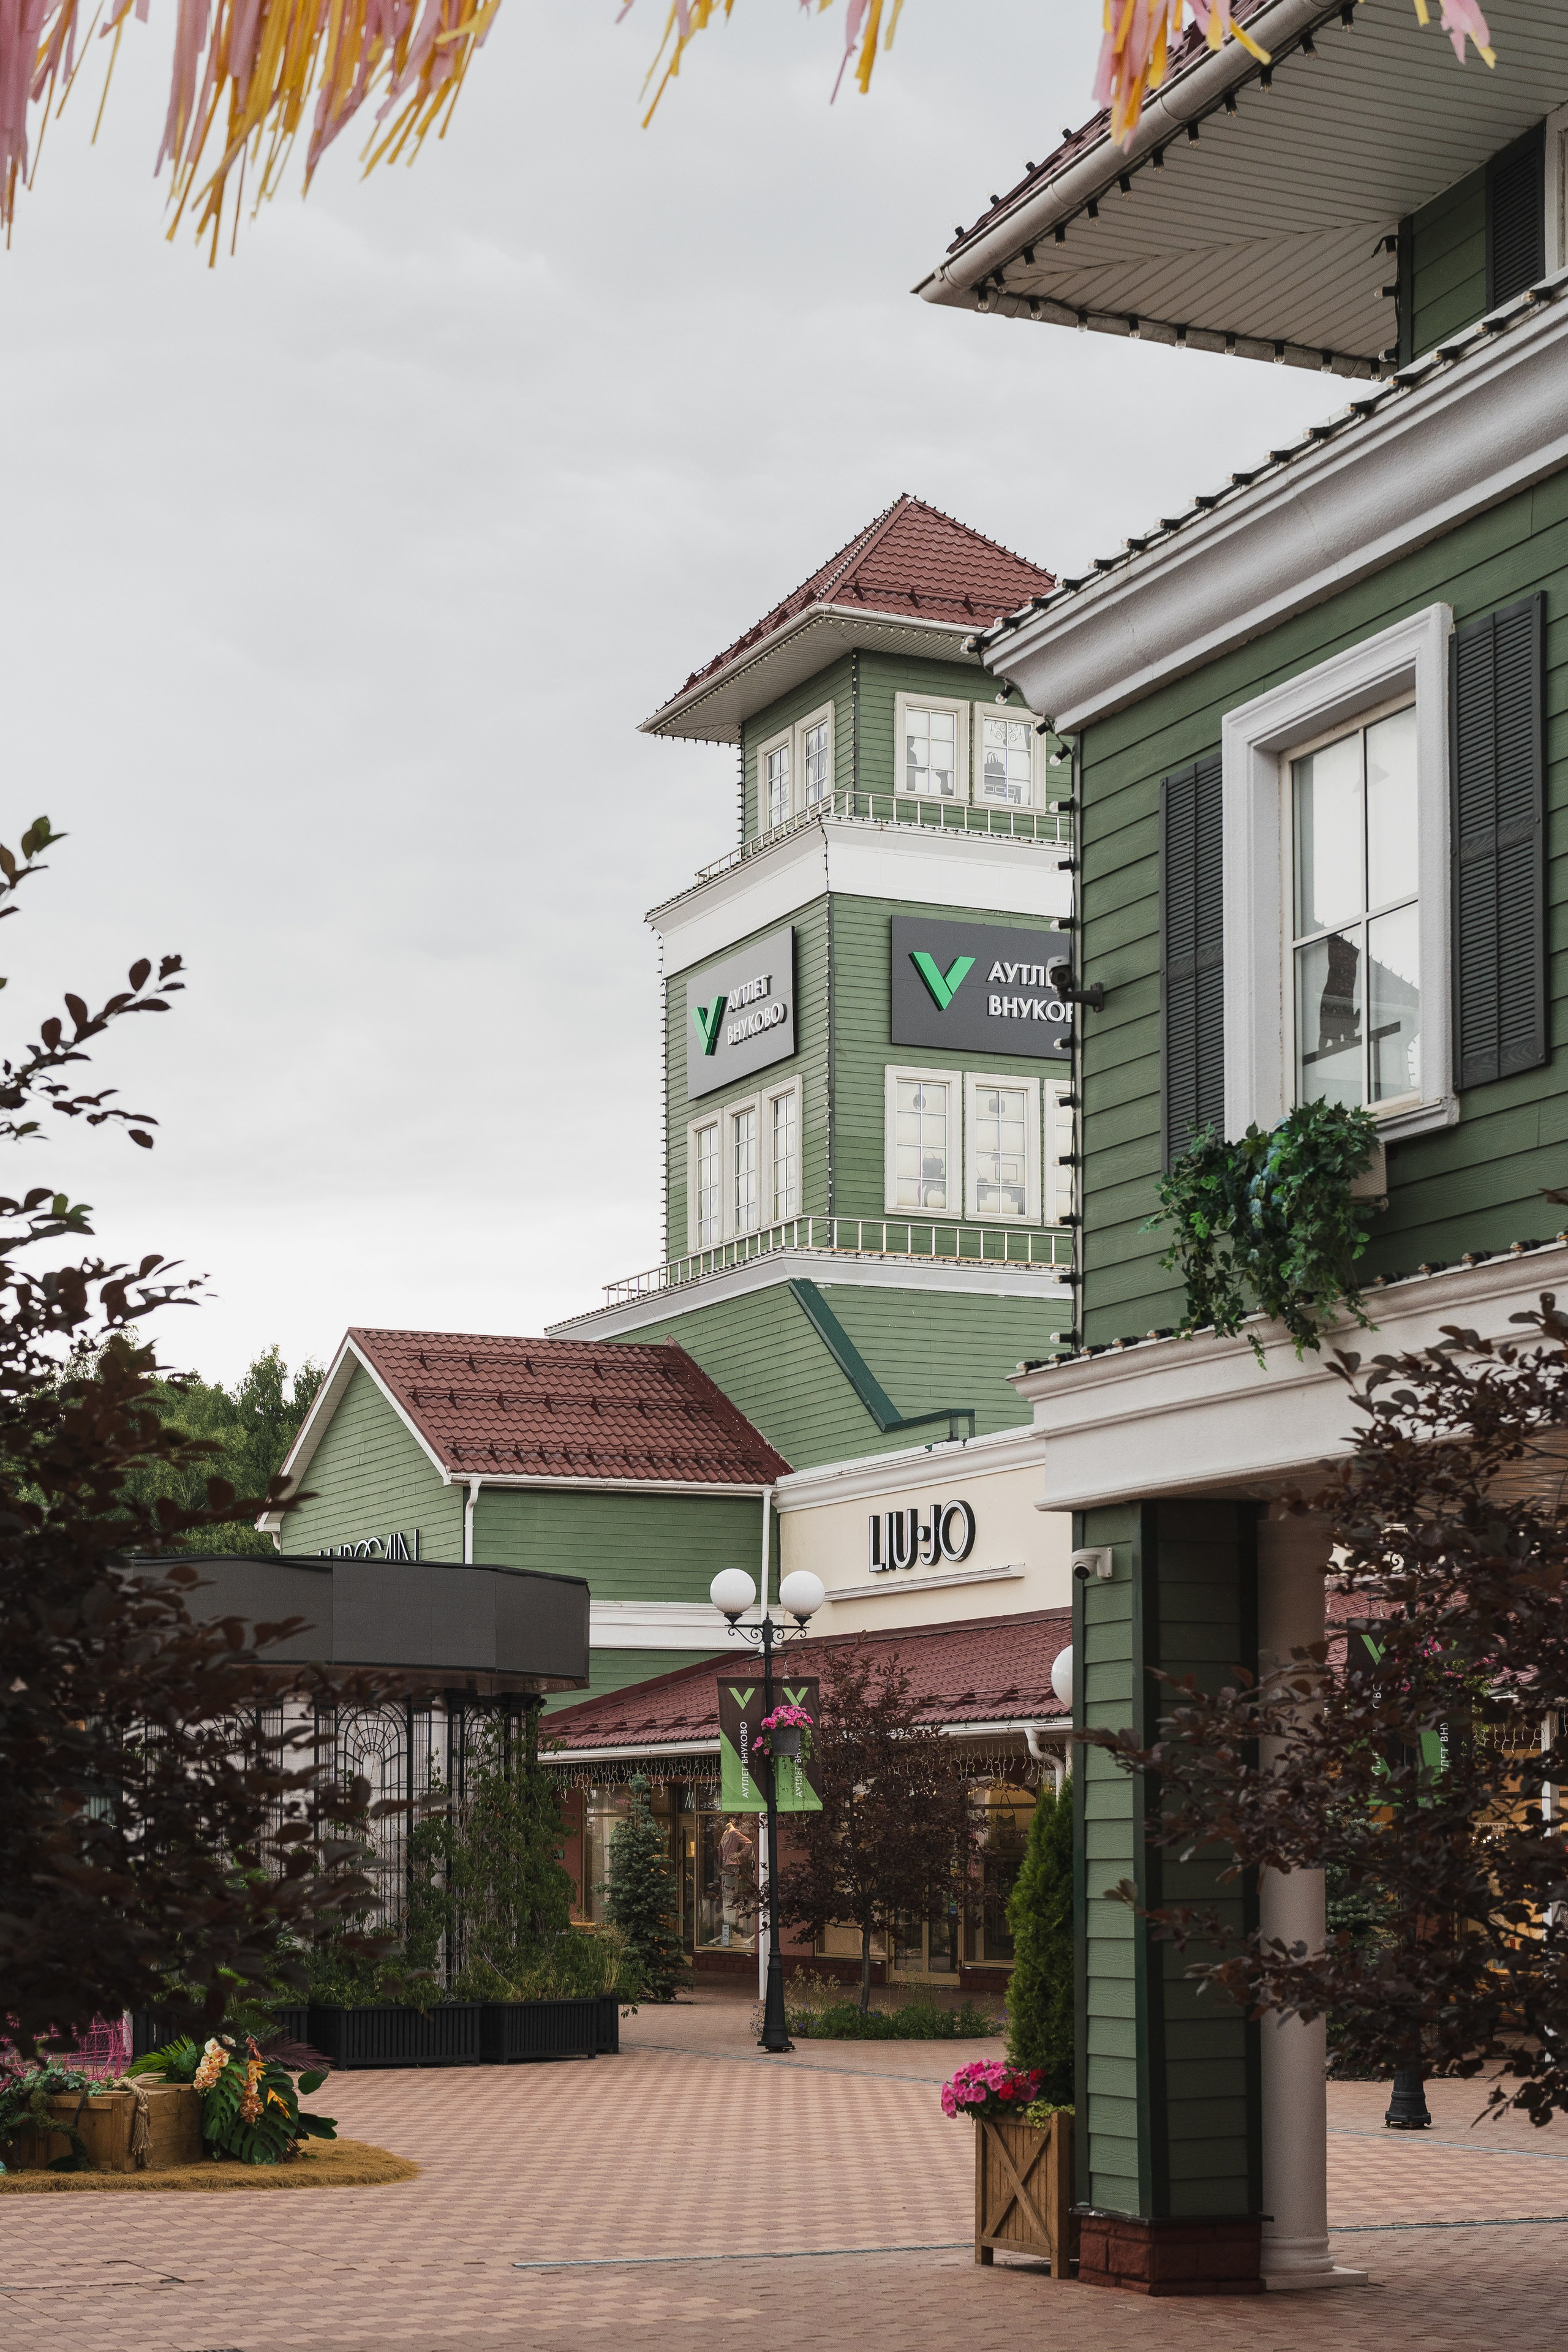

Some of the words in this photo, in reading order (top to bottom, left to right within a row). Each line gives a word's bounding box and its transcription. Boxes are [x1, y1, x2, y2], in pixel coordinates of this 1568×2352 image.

[726, 974, 772, 1012] АУТЛЕТ
[986, 960, 1054, 987] АУТЛ
[727, 1002, 787, 1046] ВНУКОВО
[739, 1721, 748, 1763] ВНУКОВО
